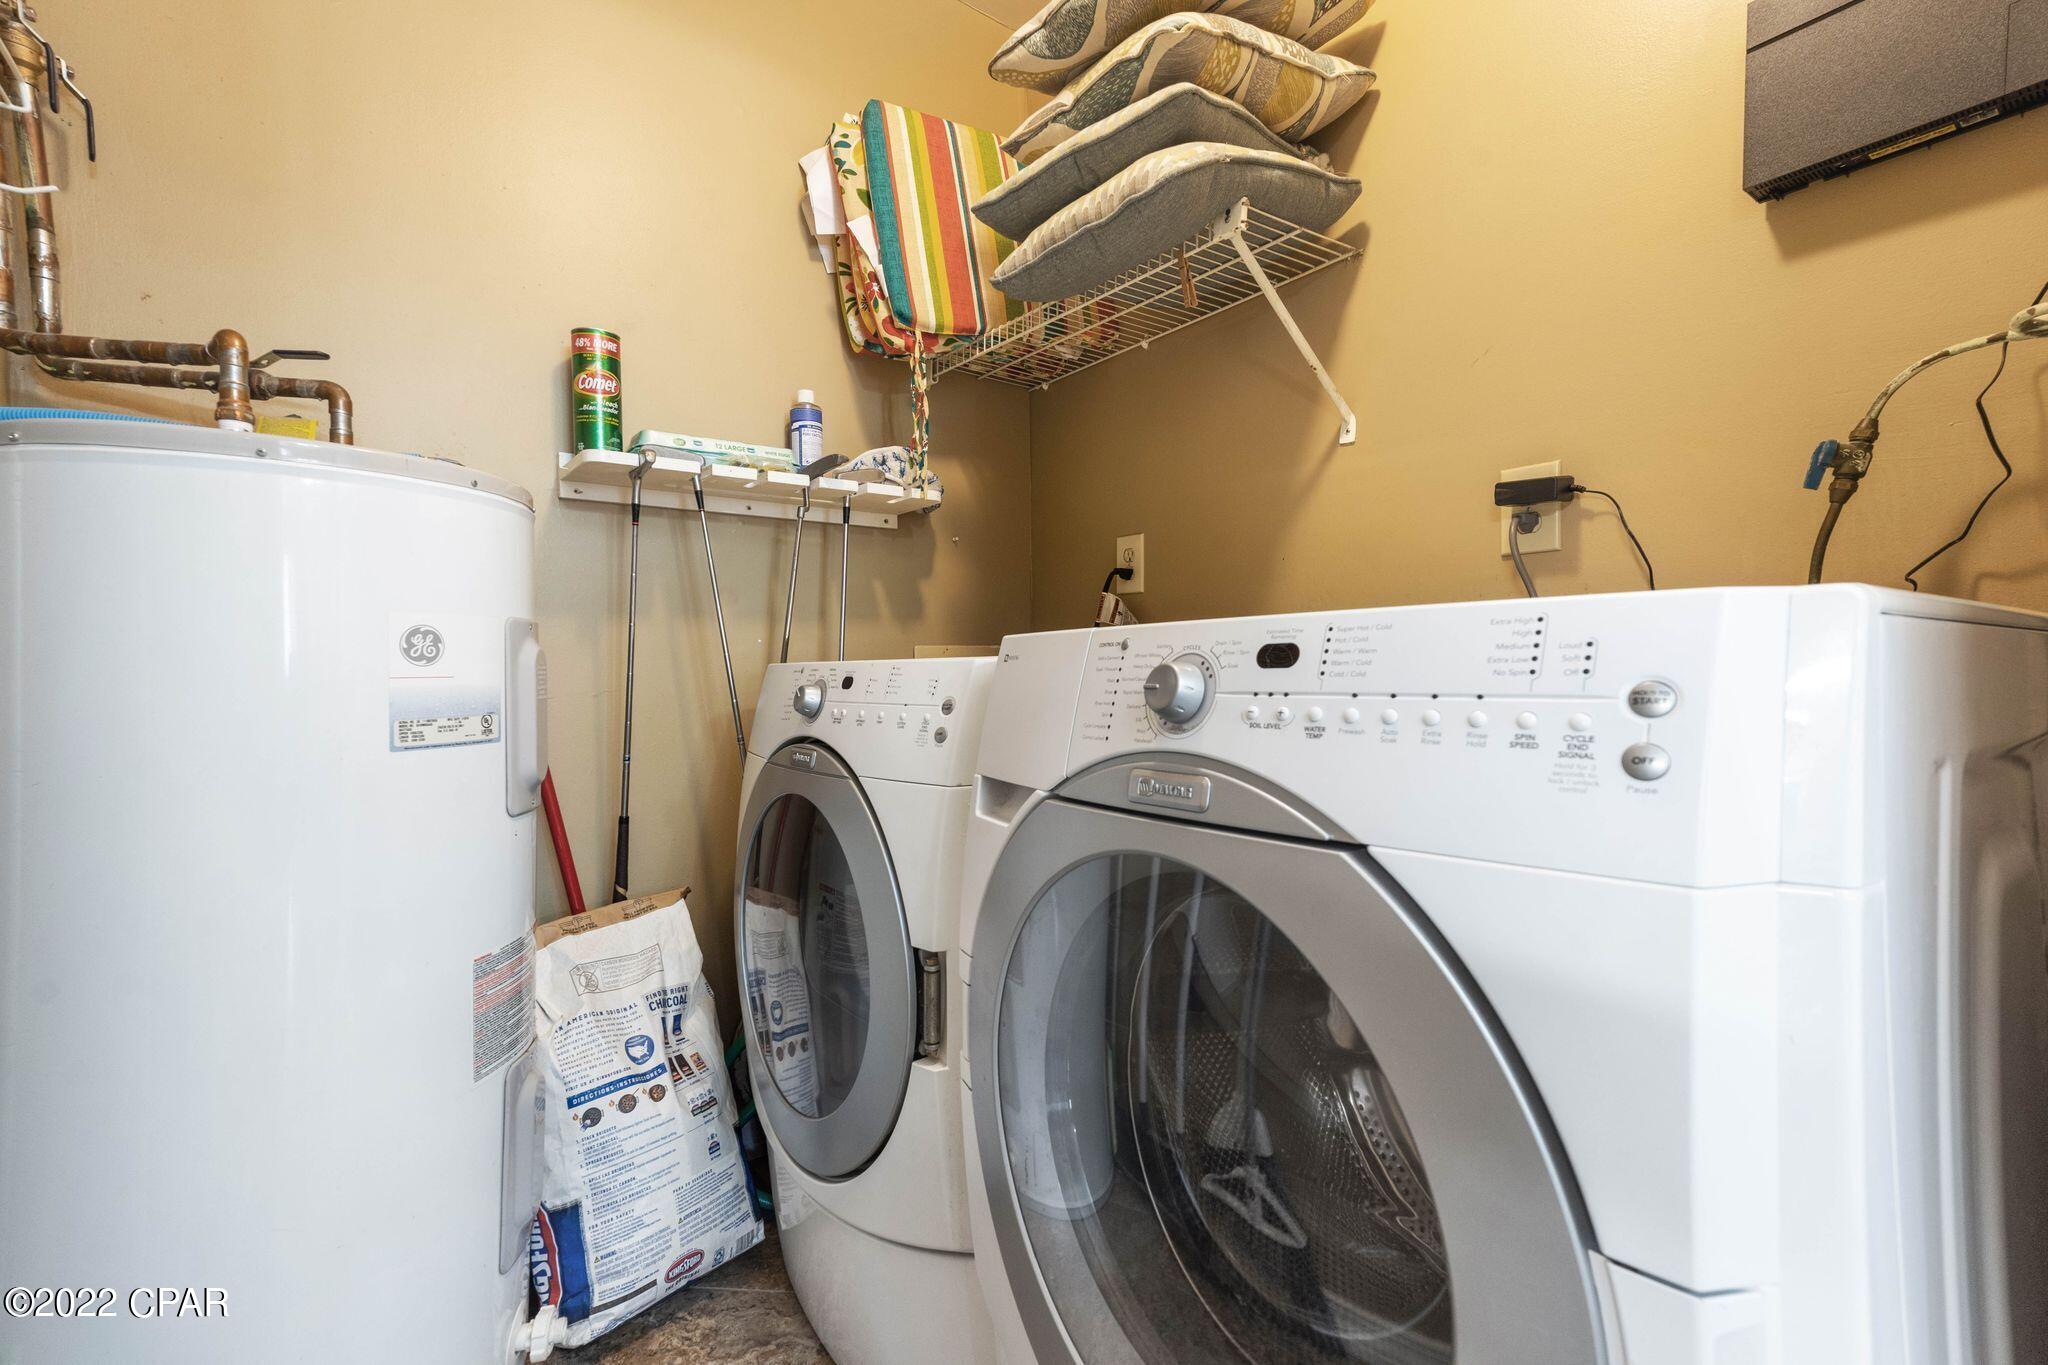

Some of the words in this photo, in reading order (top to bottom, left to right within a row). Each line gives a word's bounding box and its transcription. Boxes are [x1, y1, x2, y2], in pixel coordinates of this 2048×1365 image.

[575, 338, 590, 347] 48%
[593, 338, 618, 352] MORE
[578, 374, 617, 393] Comet
[724, 444, 746, 453] LARGE
[1562, 734, 1596, 743] CYCLE
[1509, 741, 1540, 749] SPEED
[1567, 743, 1589, 751] END
[1558, 751, 1595, 760] SIGNAL
[1632, 756, 1654, 766] OFF
[645, 990, 662, 1002] FIND
[670, 985, 688, 996] RIGHT
[566, 1011, 604, 1026] AMERICAN
[606, 1002, 638, 1016] ORIGINAL
[669, 1253, 702, 1278] KINGSFORD
